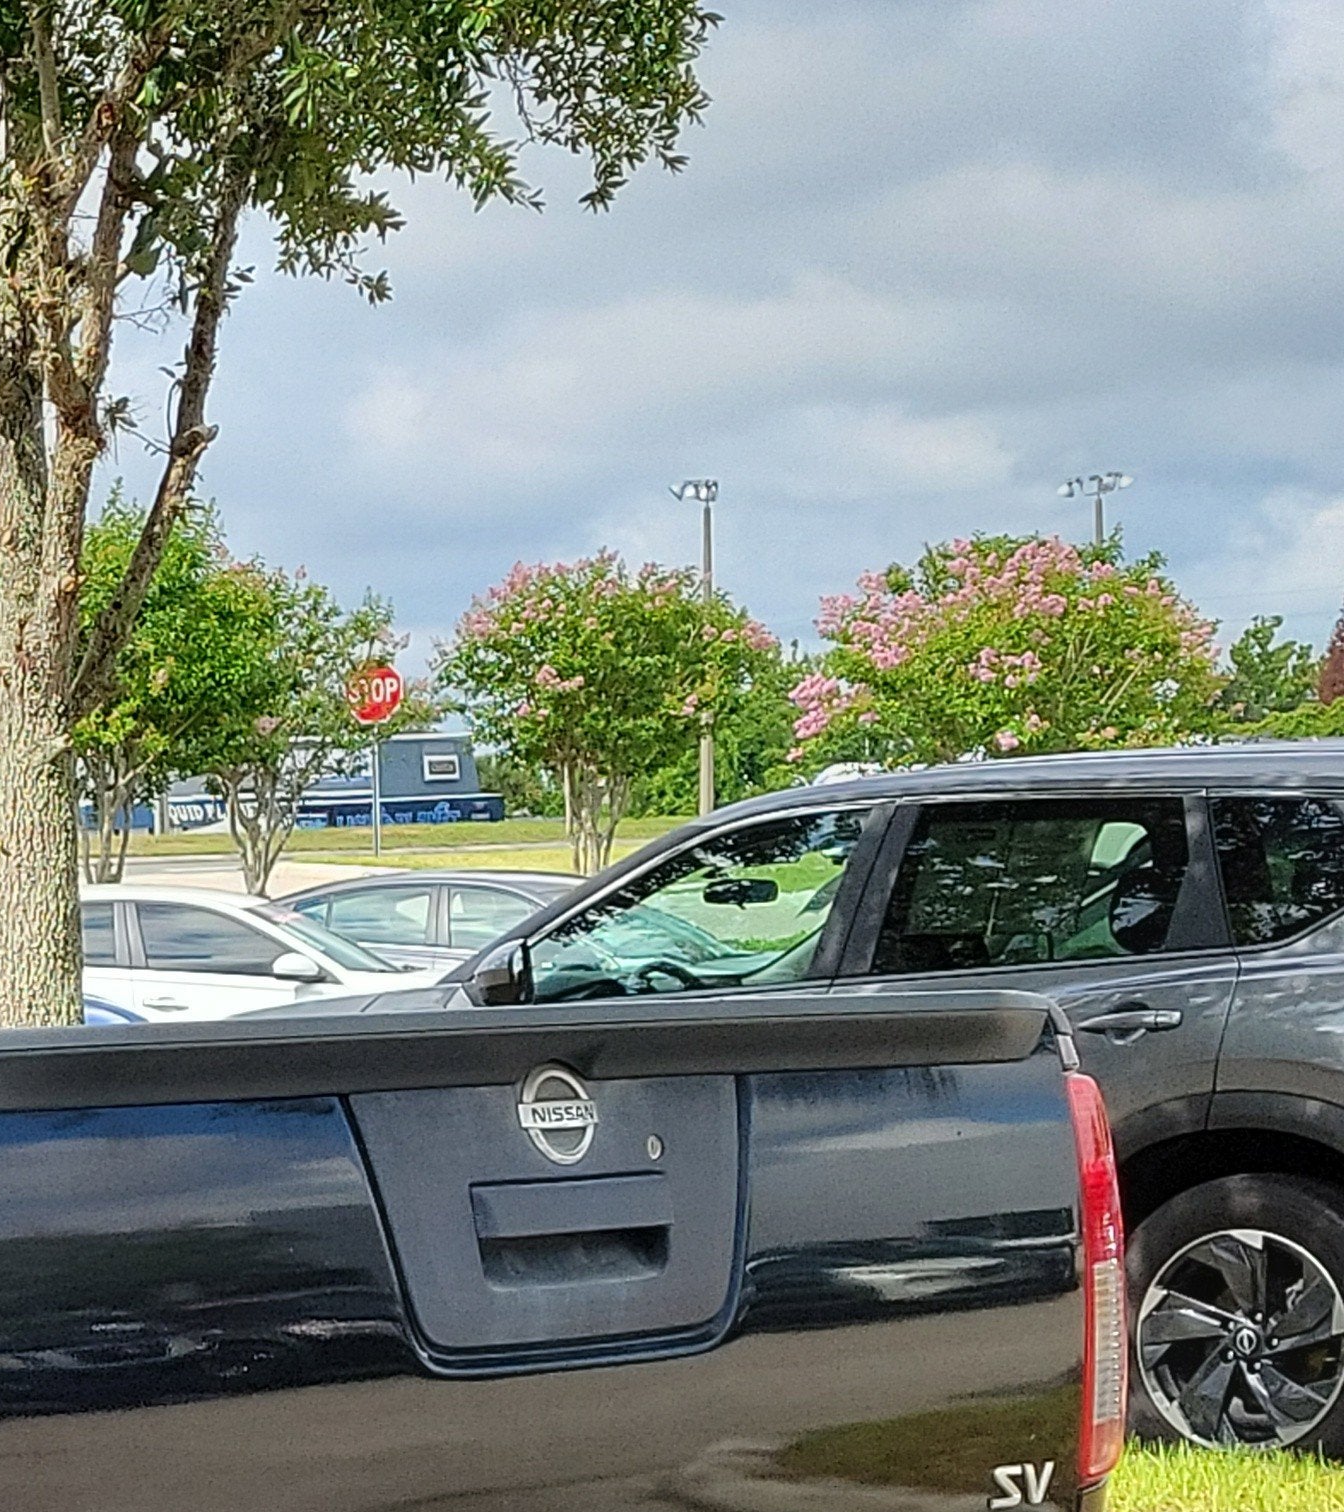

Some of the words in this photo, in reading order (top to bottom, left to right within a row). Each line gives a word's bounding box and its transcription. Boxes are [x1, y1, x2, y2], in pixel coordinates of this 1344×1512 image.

[168, 803, 204, 825] QUID
[530, 1104, 595, 1124] NISSAN
[988, 1460, 1055, 1509] SV
